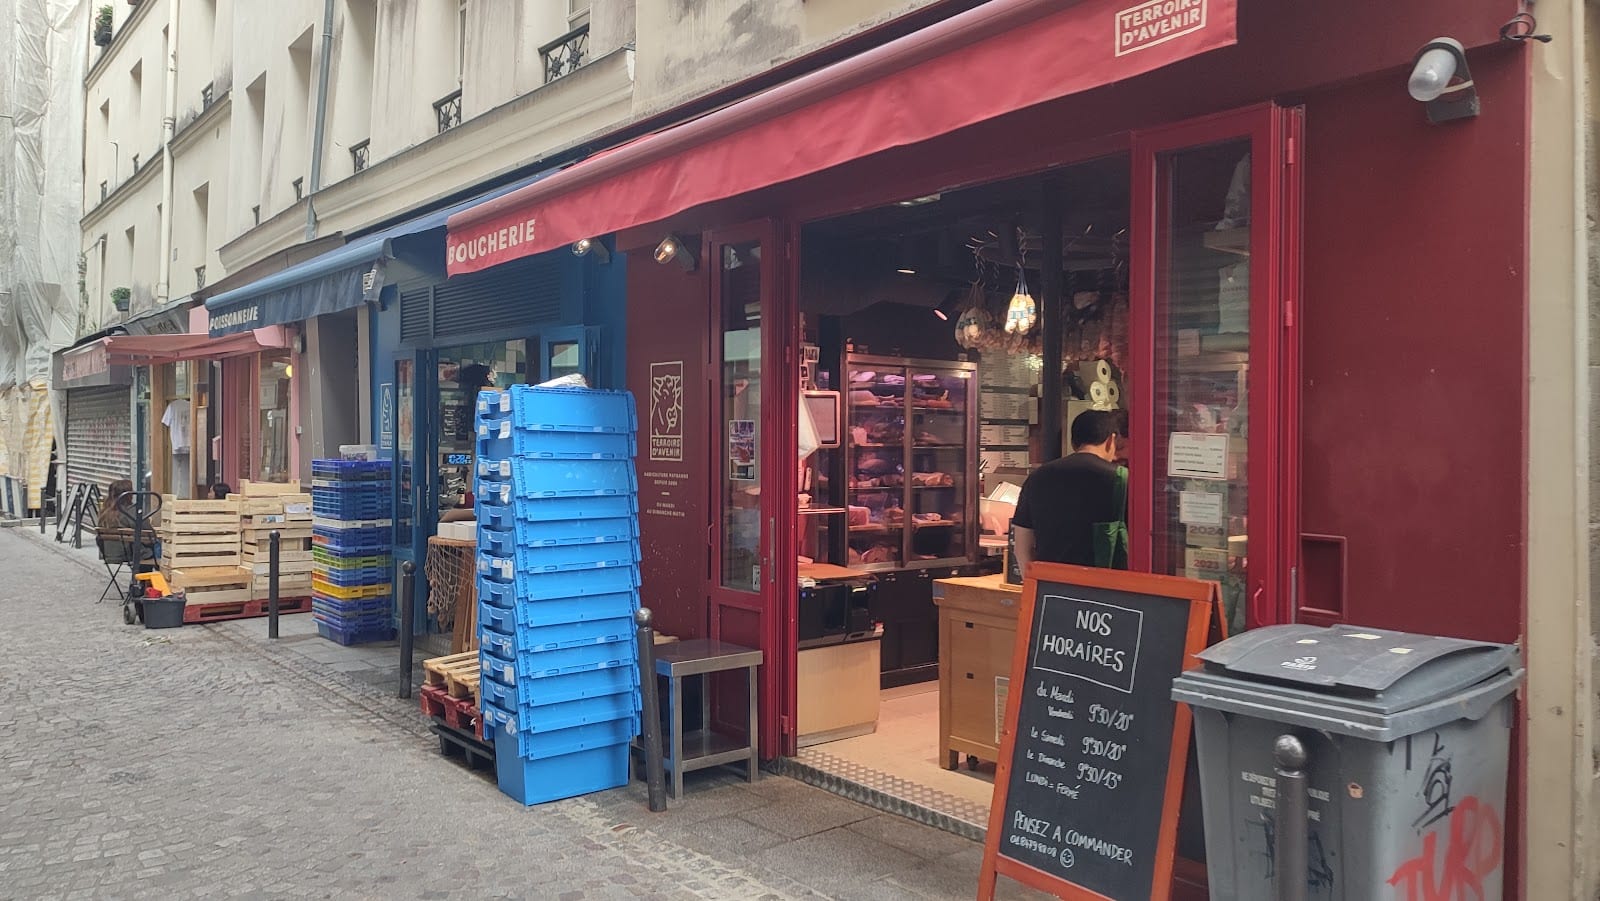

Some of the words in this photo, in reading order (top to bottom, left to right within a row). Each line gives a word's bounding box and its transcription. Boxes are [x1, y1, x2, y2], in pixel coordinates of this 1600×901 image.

[1122, 8, 1200, 46] D'AVENIR
[447, 219, 536, 266] BOUCHERIE
[652, 447, 681, 457] D'AVENIR
[1075, 609, 1113, 637] NOS
[1014, 810, 1050, 837] PENSEZ
[1052, 826, 1061, 842] A
[1065, 830, 1133, 866] COMMANDER
